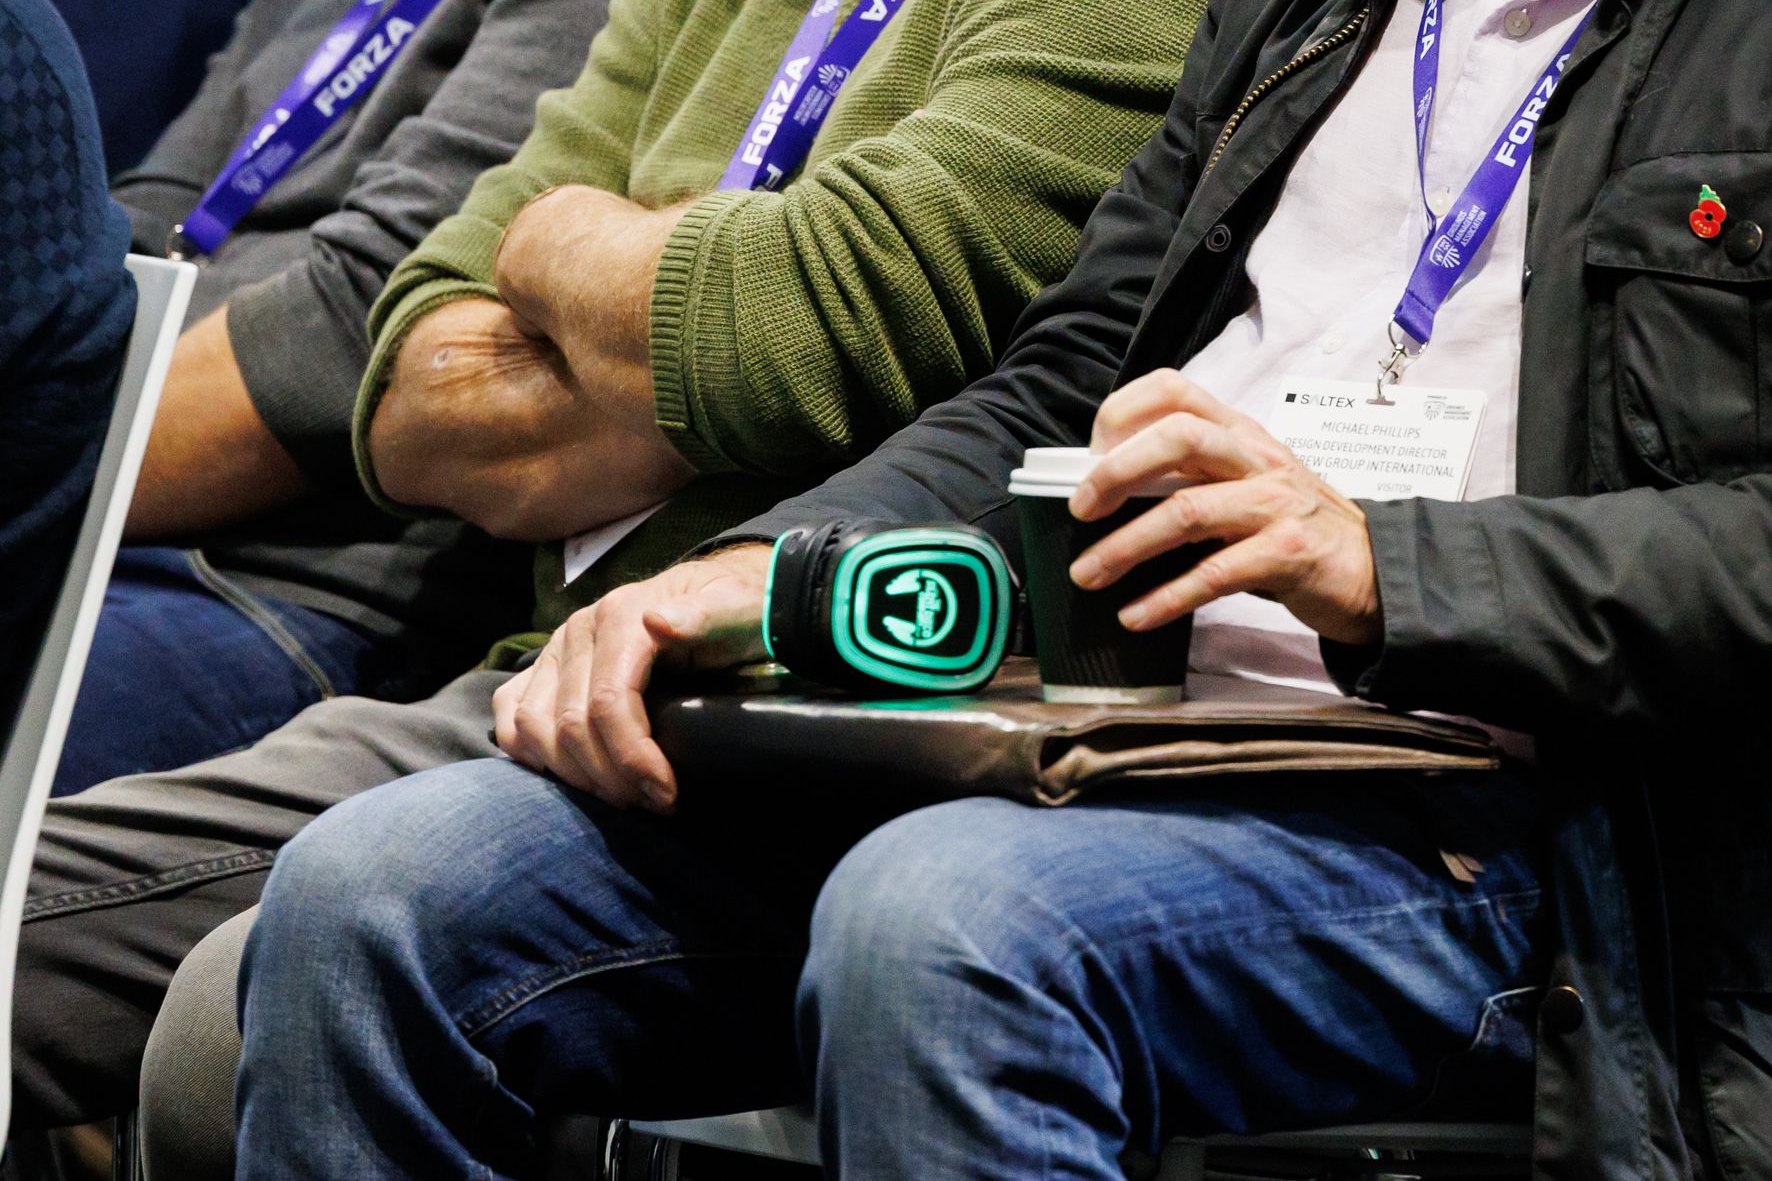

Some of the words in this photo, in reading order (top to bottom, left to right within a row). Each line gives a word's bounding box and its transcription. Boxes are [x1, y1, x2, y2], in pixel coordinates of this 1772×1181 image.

[313, 17, 415, 117] FORZA
[741, 56, 811, 167] FORZA
[1321, 421, 1369, 435] MICHAEL
[1372, 425, 1421, 439] PHILLIPS
[1284, 437, 1320, 450] DESIGN
[1322, 442, 1396, 456] DEVELOPMENT
[1397, 448, 1447, 460] DIRECTOR
[1325, 458, 1365, 470] GROUP
[1367, 461, 1455, 478] INTERNATIONAL
